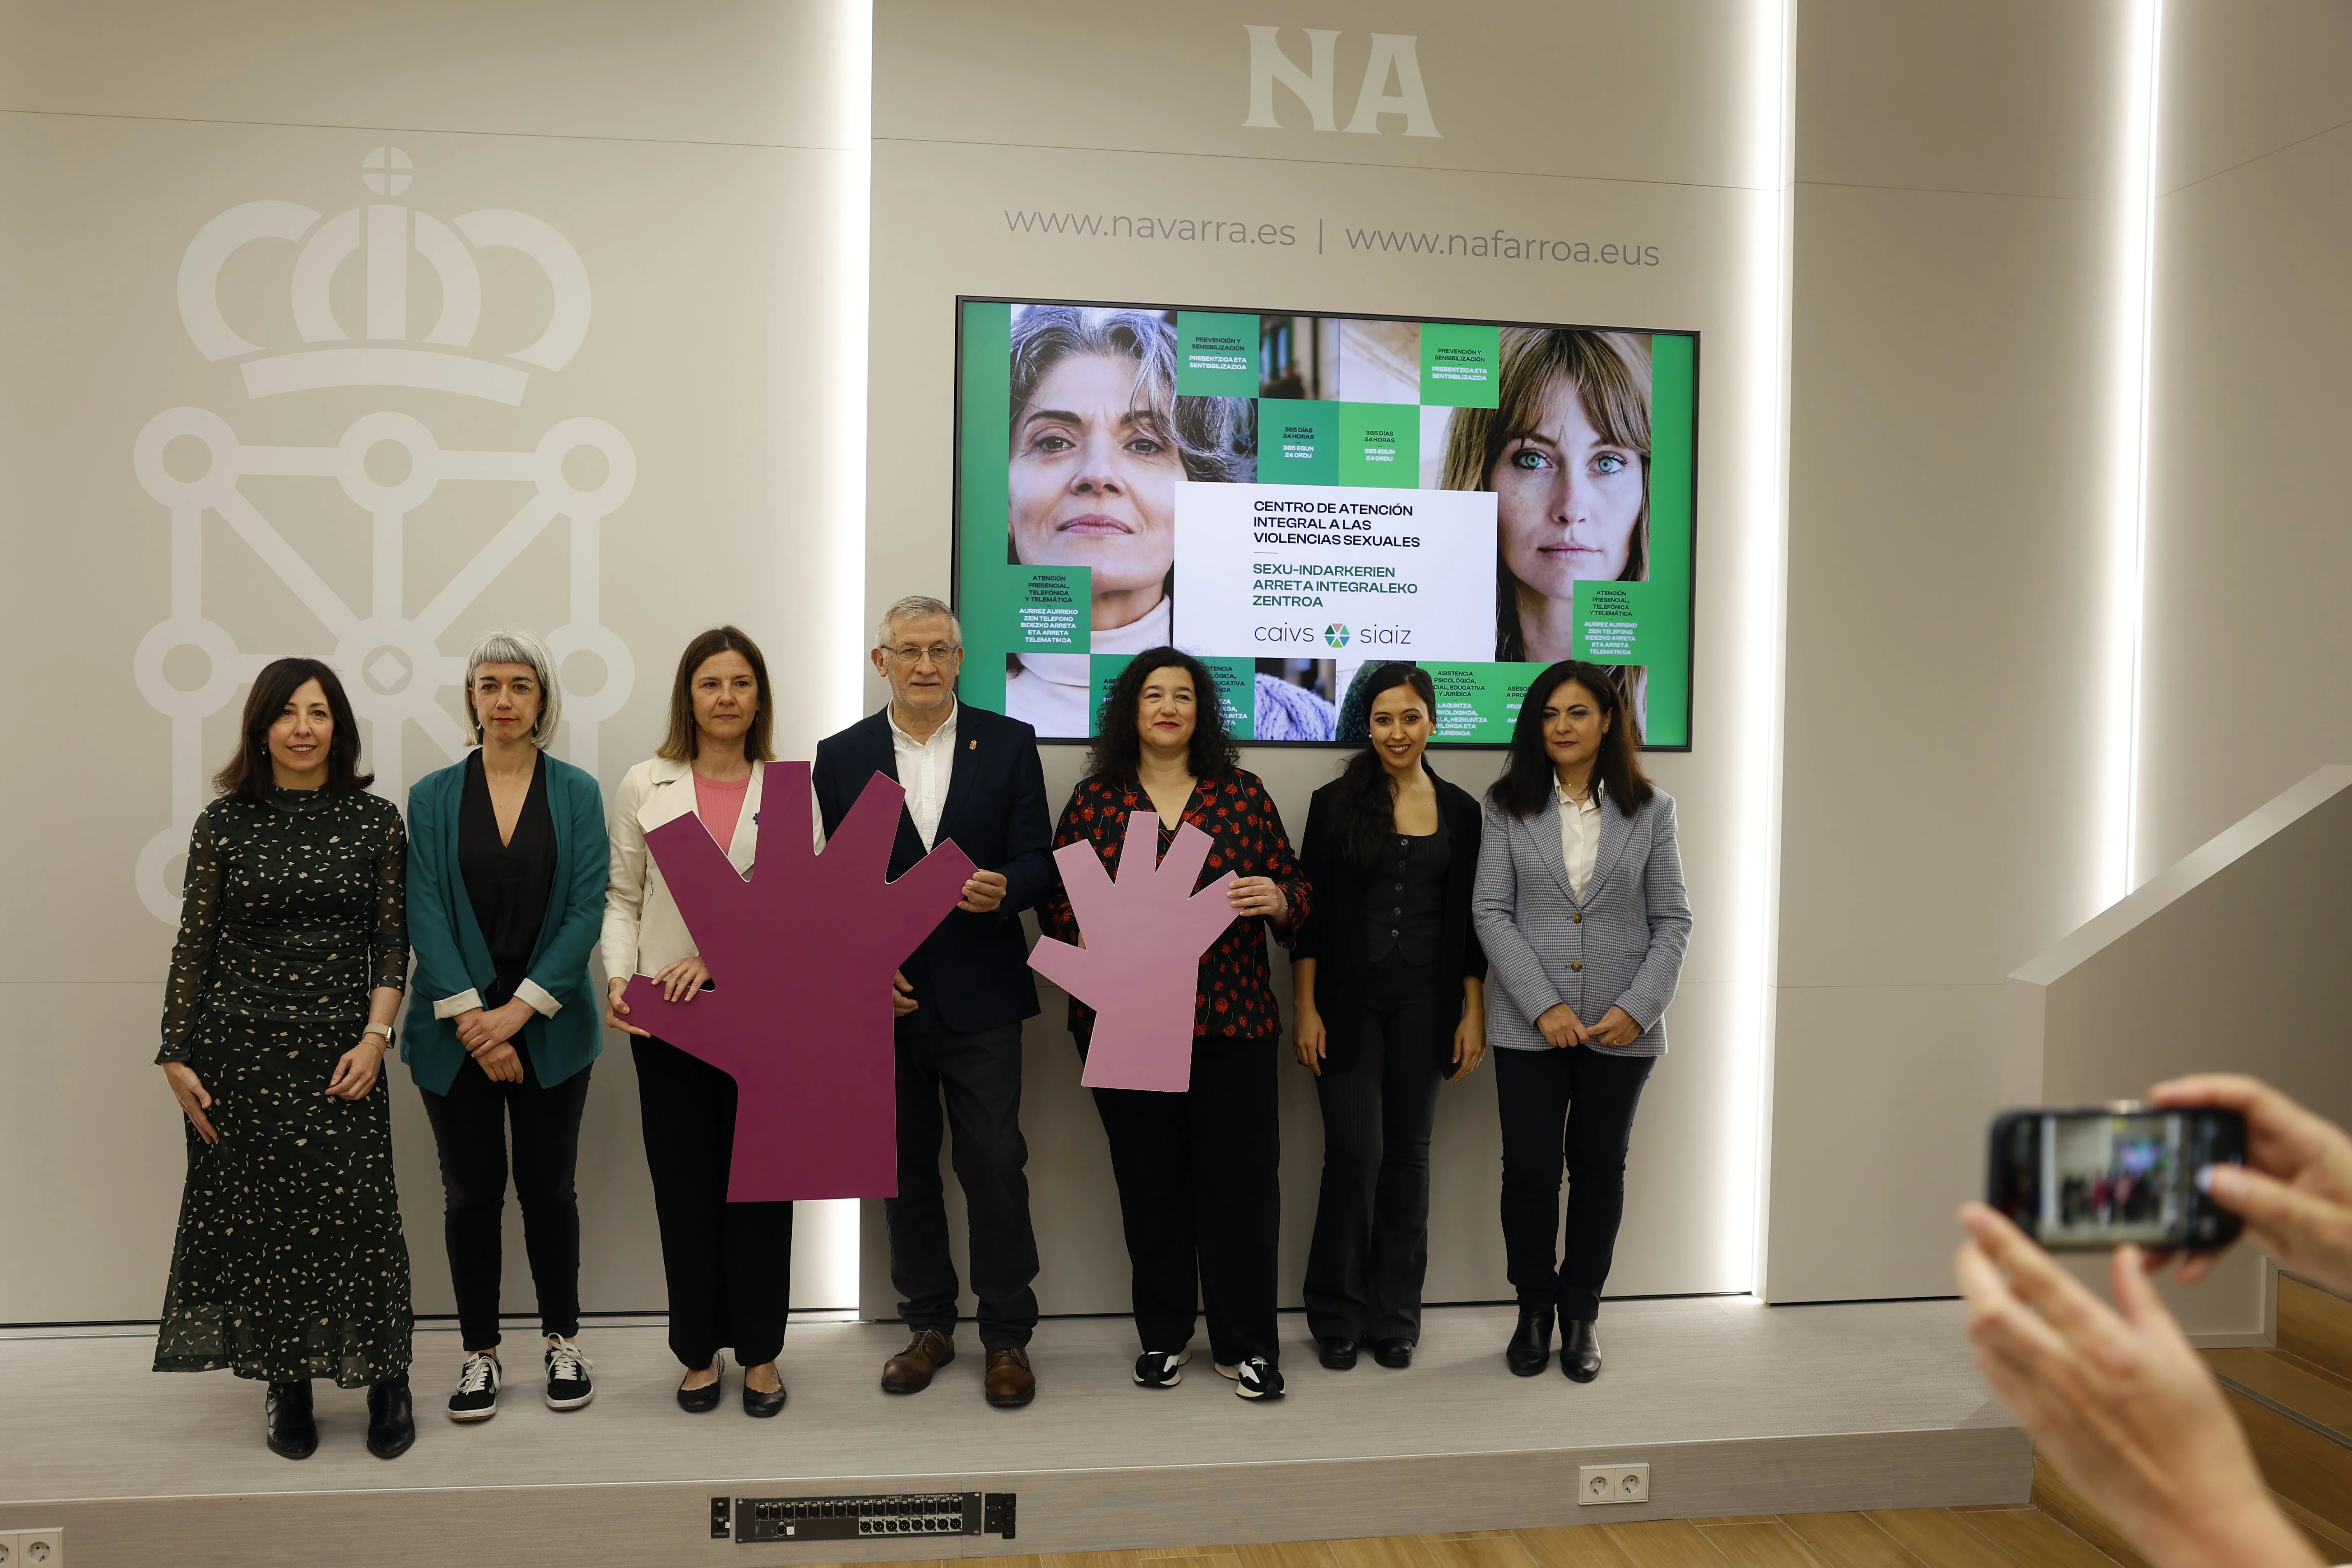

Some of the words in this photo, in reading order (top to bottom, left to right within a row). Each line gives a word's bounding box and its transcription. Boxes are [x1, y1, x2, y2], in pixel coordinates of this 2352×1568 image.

[1241, 24, 1444, 138] NA
[1004, 210, 1296, 247] www.navarra.es
[1345, 225, 1660, 267] www.nafarroa.eus
[1254, 501, 1314, 513] CENTRO
[1317, 503, 1336, 513] DE
[1338, 503, 1413, 516] ATENCIÓN
[1254, 517, 1327, 529] INTEGRAL
[1329, 520, 1340, 529] A
[1343, 520, 1371, 530] LAS
[1254, 532, 1341, 545] VIOLENCIAS
[1343, 535, 1420, 547] SEXUALES
[1253, 564, 1395, 578] SEXU-INDARKERIEN
[1253, 580, 1314, 591] ARRETA
[1316, 581, 1417, 594] INTEGRALEKO
[1253, 595, 1323, 607] ZENTROA
[1254, 622, 1314, 642] caivs
[1360, 624, 1411, 645] siaiz
